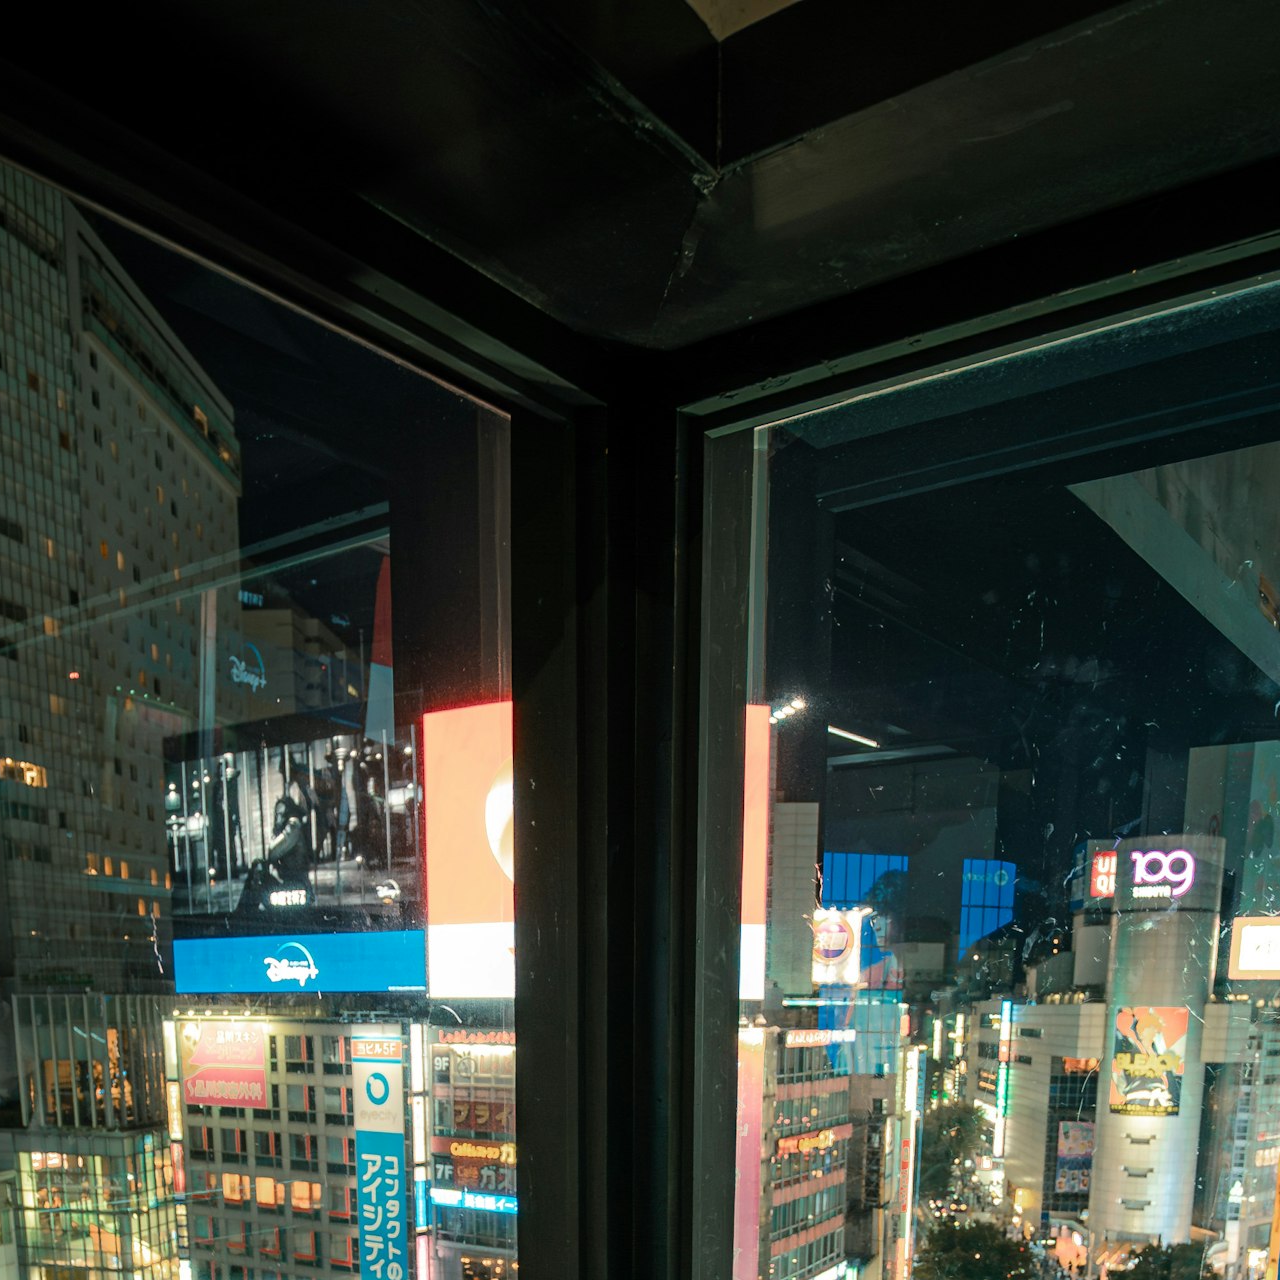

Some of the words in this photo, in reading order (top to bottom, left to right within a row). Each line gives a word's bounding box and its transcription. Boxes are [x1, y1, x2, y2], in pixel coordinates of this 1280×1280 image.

[1130, 849, 1196, 898] 109
[434, 1056, 450, 1070] 9F
[435, 1163, 454, 1179] 7F
[361, 1153, 385, 1279] アイシティ
[384, 1155, 403, 1280] コンタクトの
